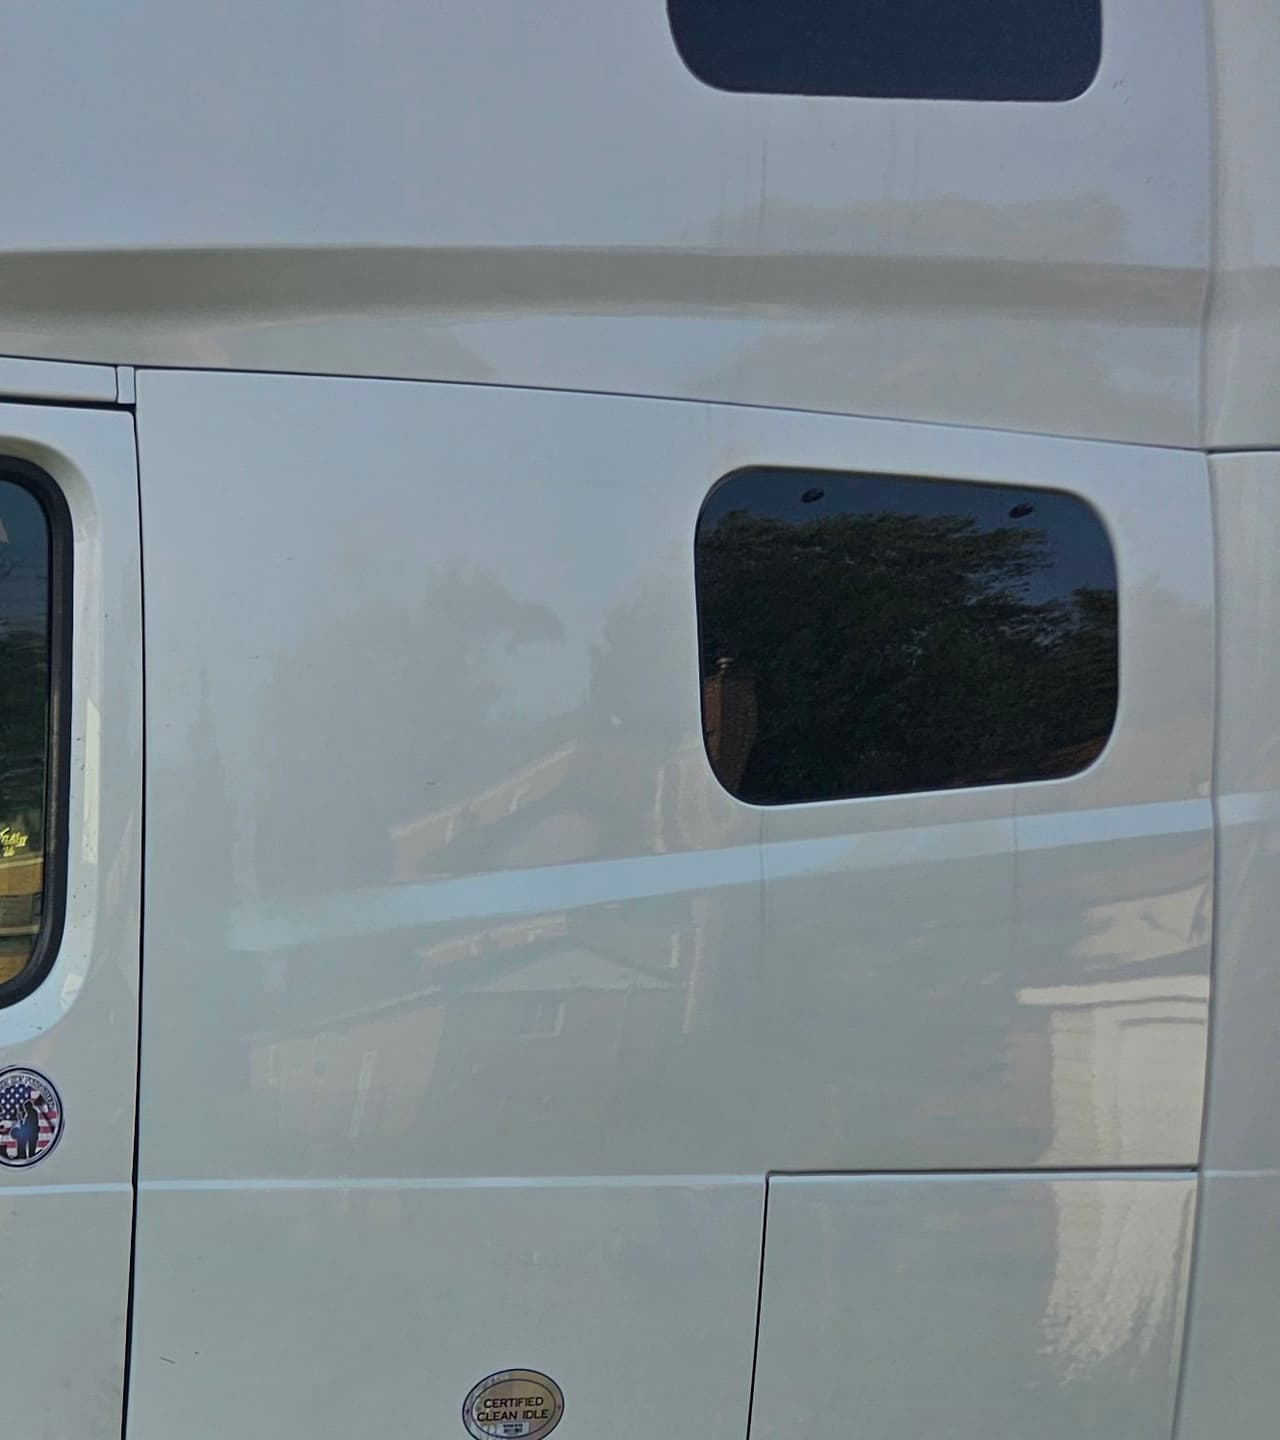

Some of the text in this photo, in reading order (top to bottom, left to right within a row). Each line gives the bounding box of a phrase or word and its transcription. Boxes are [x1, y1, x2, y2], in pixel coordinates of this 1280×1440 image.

[483, 1396, 544, 1409] CERTIFIED
[477, 1409, 550, 1422] CLEAN IDLE
